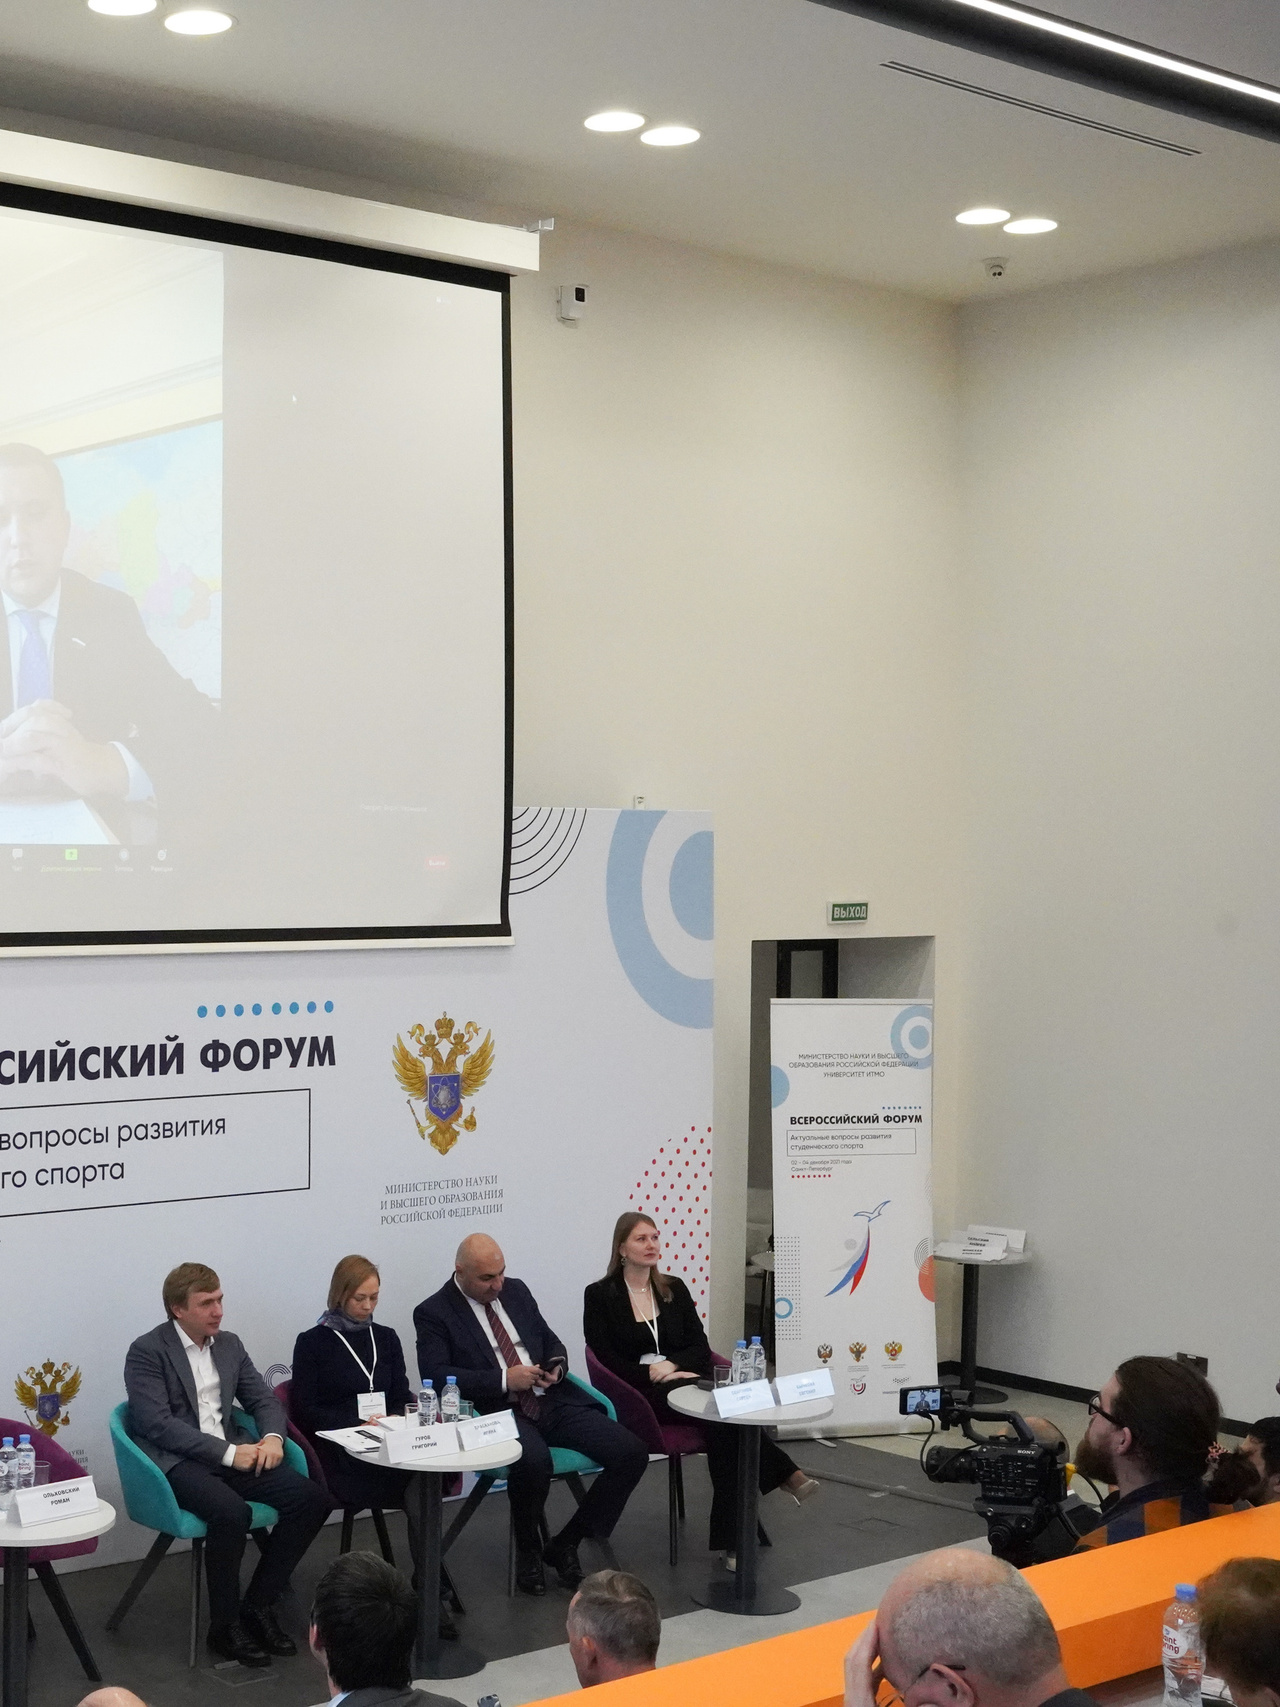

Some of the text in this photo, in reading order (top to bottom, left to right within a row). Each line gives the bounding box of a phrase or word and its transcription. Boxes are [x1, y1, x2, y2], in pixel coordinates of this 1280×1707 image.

[833, 905, 867, 919] ВЫХОД
[199, 1034, 337, 1073] ФОРУМ
[877, 1052, 910, 1060] ВЫСШЕГО
[788, 1060, 919, 1069] ОБРАЗОВАНИЯ РОССИЙСКОЙ ФЕДЕРАЦИИ
[790, 1114, 923, 1125] ВСЕРОССИЙСКИЙ ФОРУМ
[116, 1113, 227, 1148] развития
[861, 1133, 892, 1141] развития
[790, 1142, 864, 1151] студенческого спорта
[34, 1158, 126, 1192] спорта
[385, 1175, 499, 1195] МИНИСТЕРСТВО НАУКИ
[380, 1188, 504, 1210] И ВЫСШЕГО ОБРАЗОВАНИЯ
[380, 1203, 504, 1226] РОССИЙСКОЙ ФЕДЕРАЦИИ
[42, 1486, 81, 1499] ОЛЬХОВСКИЙ
[50, 1497, 71, 1505] РОМАН
